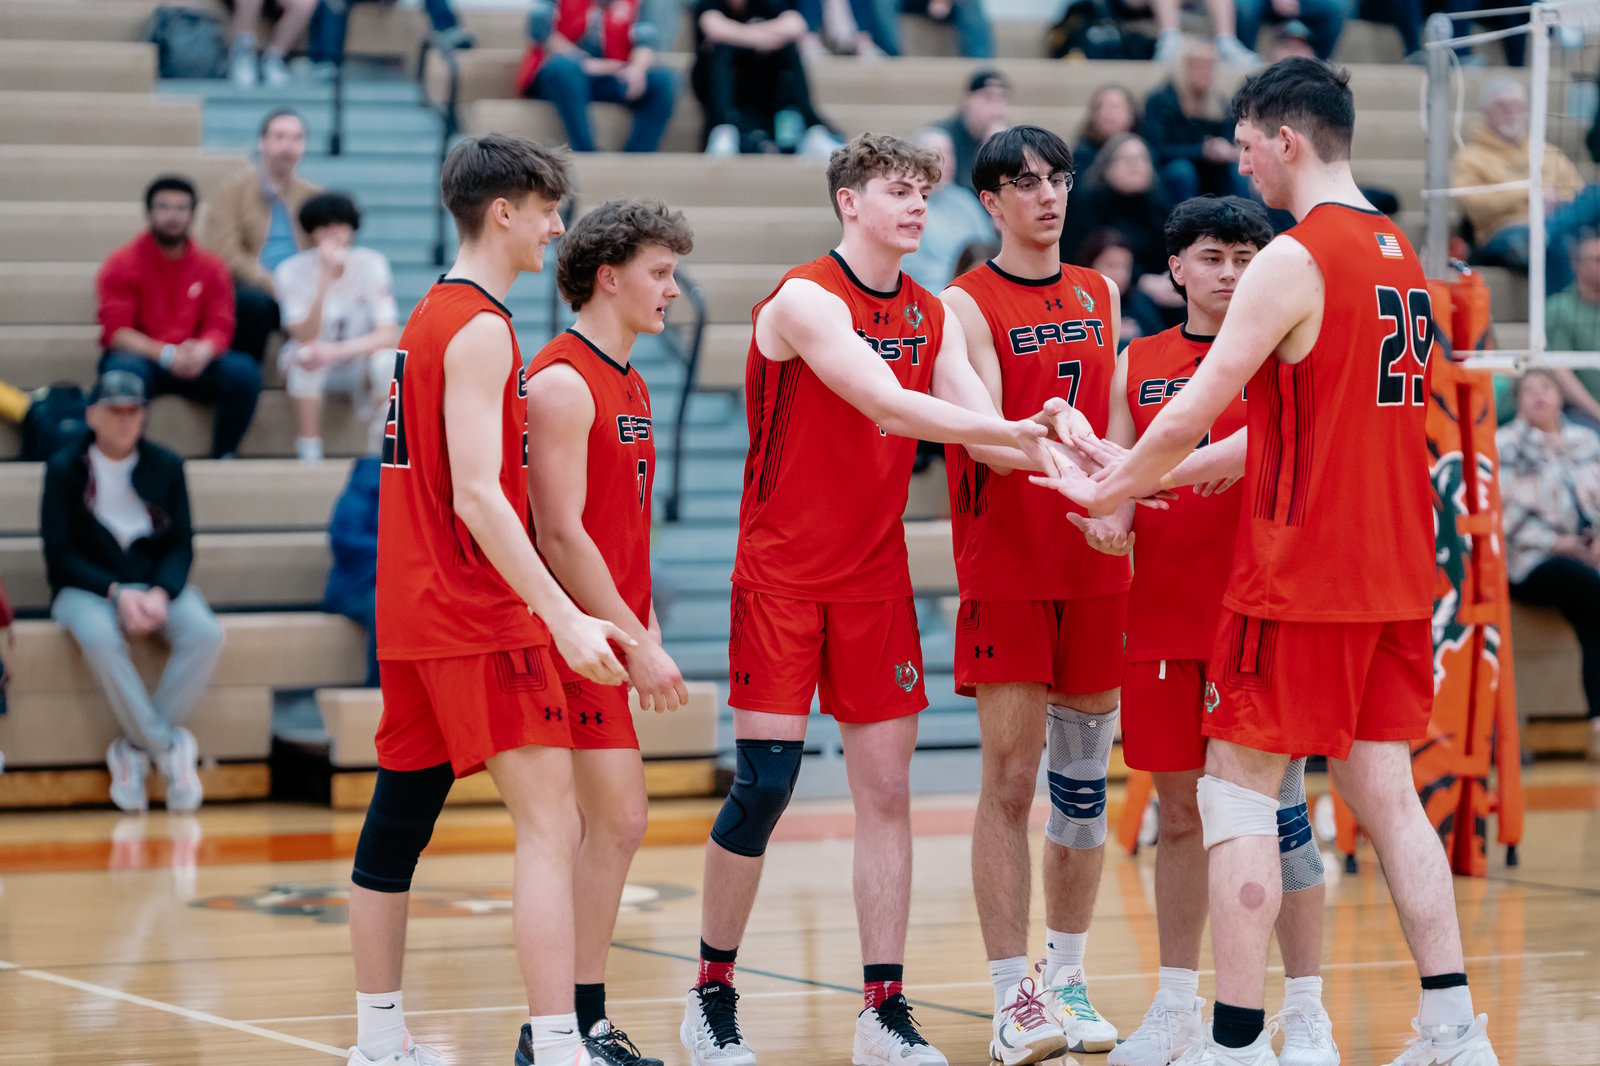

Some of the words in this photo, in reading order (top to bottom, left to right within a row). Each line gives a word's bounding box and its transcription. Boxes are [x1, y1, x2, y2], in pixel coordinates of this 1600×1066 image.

[857, 329, 927, 365] AST
[1008, 319, 1104, 355] EAST
[1375, 284, 1434, 406] 29
[1057, 360, 1081, 408] 7
